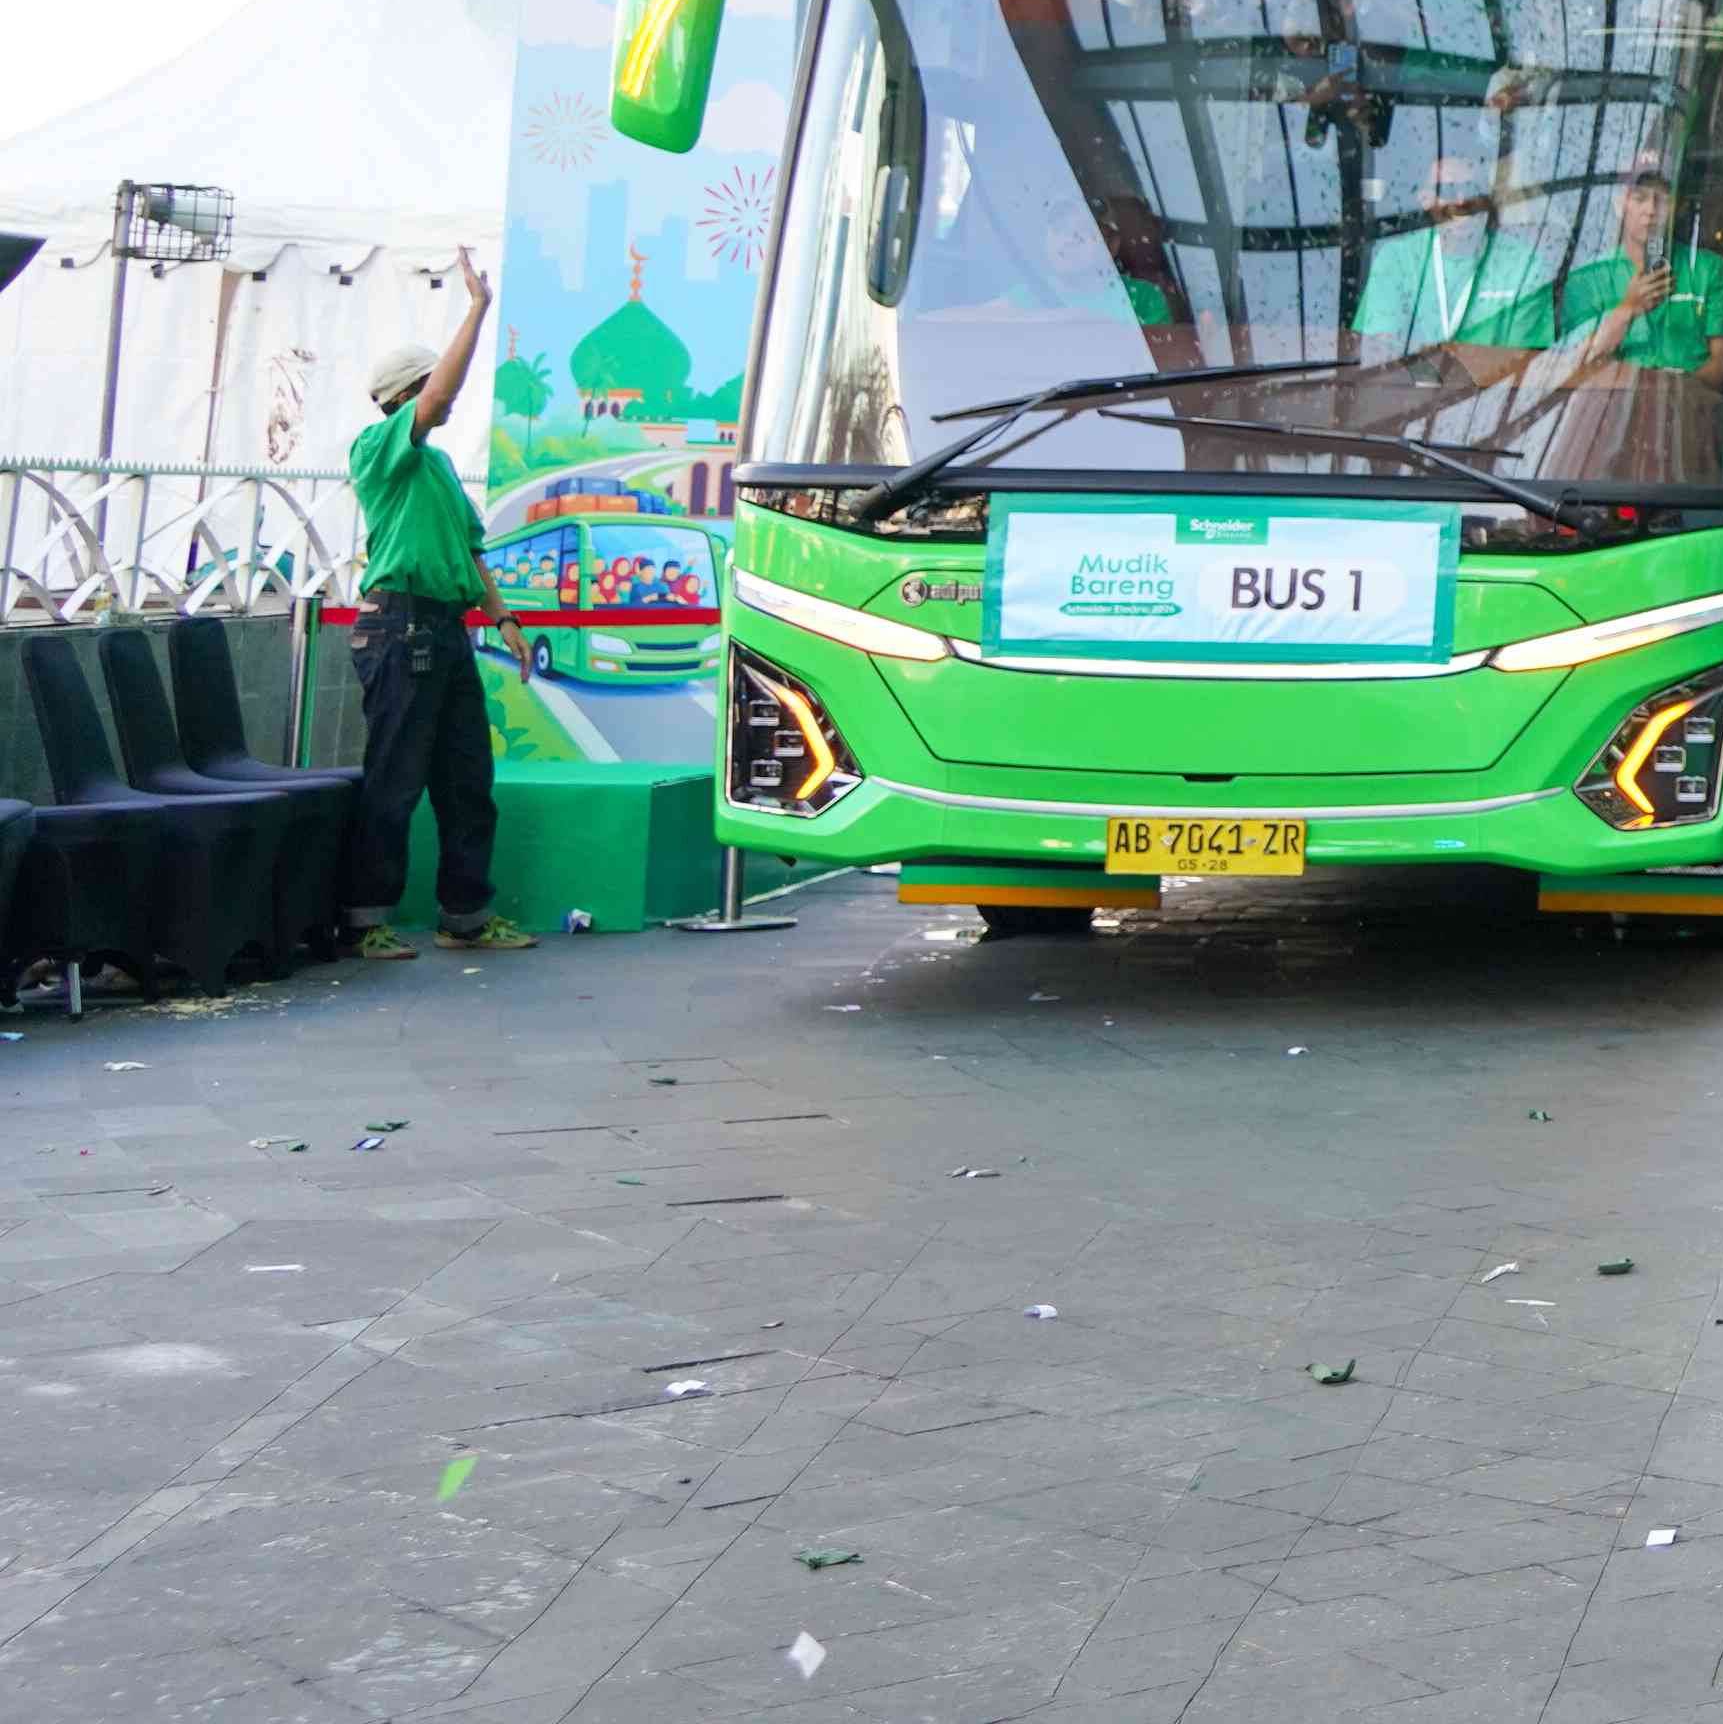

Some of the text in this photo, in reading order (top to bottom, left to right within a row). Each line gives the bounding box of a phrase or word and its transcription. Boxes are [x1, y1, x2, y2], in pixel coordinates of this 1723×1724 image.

[1078, 553, 1168, 574] Mudik
[1071, 575, 1174, 600] Bareng
[1232, 566, 1362, 611] BUS 1
[1115, 822, 1300, 855] AB 7041 ZR
